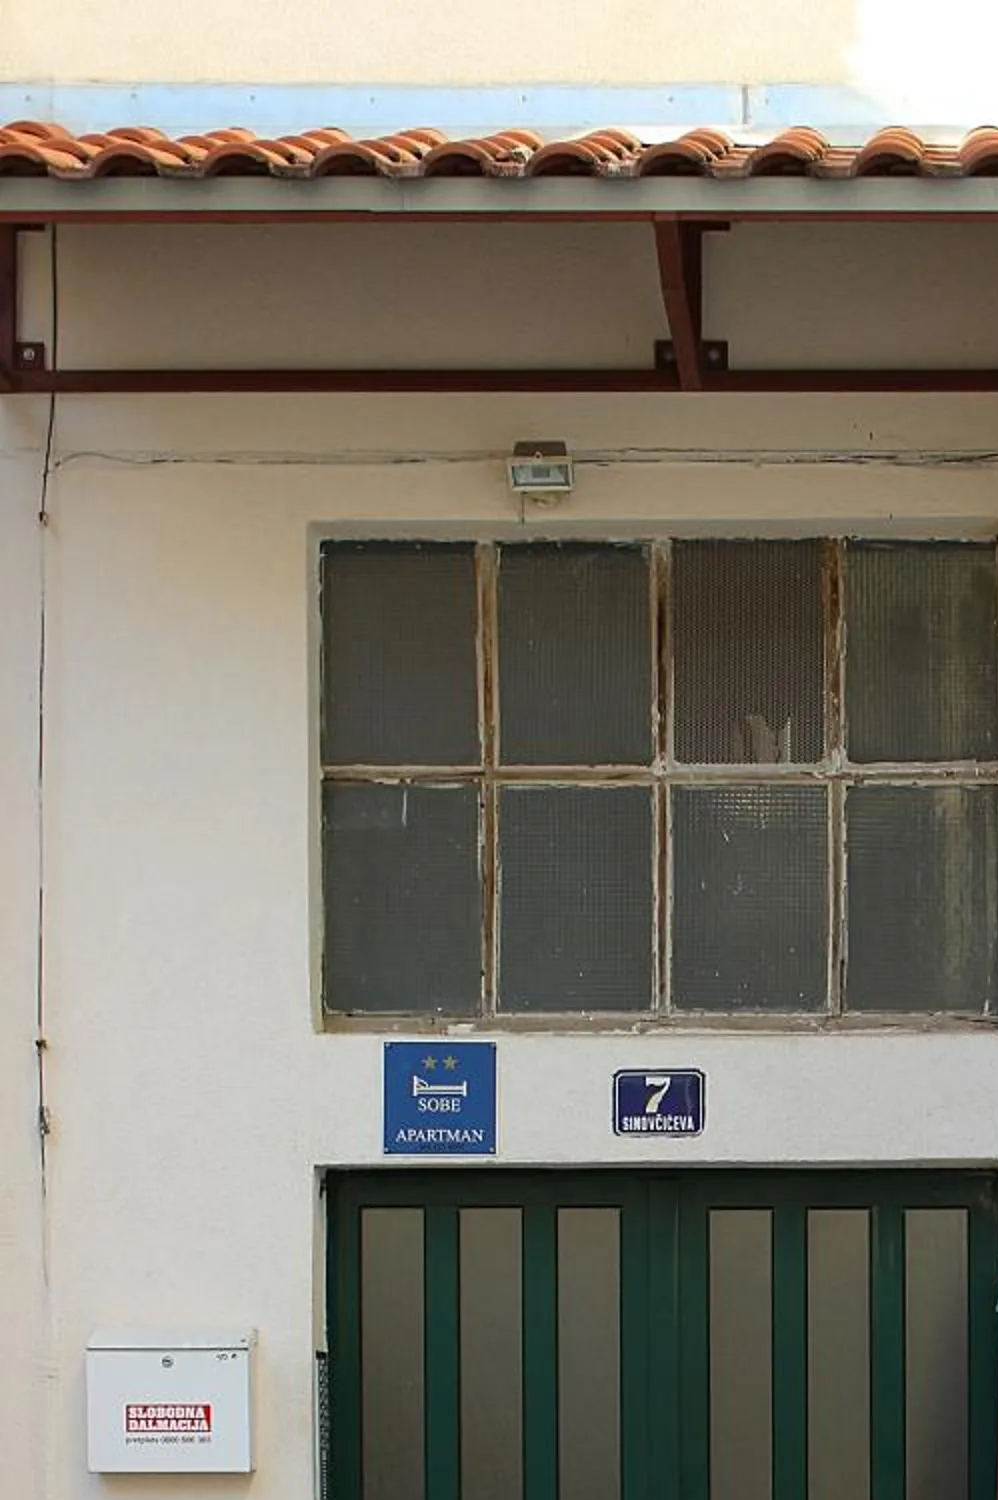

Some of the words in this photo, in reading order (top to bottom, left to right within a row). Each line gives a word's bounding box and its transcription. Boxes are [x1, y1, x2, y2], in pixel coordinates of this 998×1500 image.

[645, 1076, 671, 1113] 7
[418, 1098, 461, 1113] SOBE
[395, 1129, 484, 1142] APARTMAN
[128, 1407, 205, 1419] SLOBODNA
[128, 1419, 209, 1430] DALMACIJA
